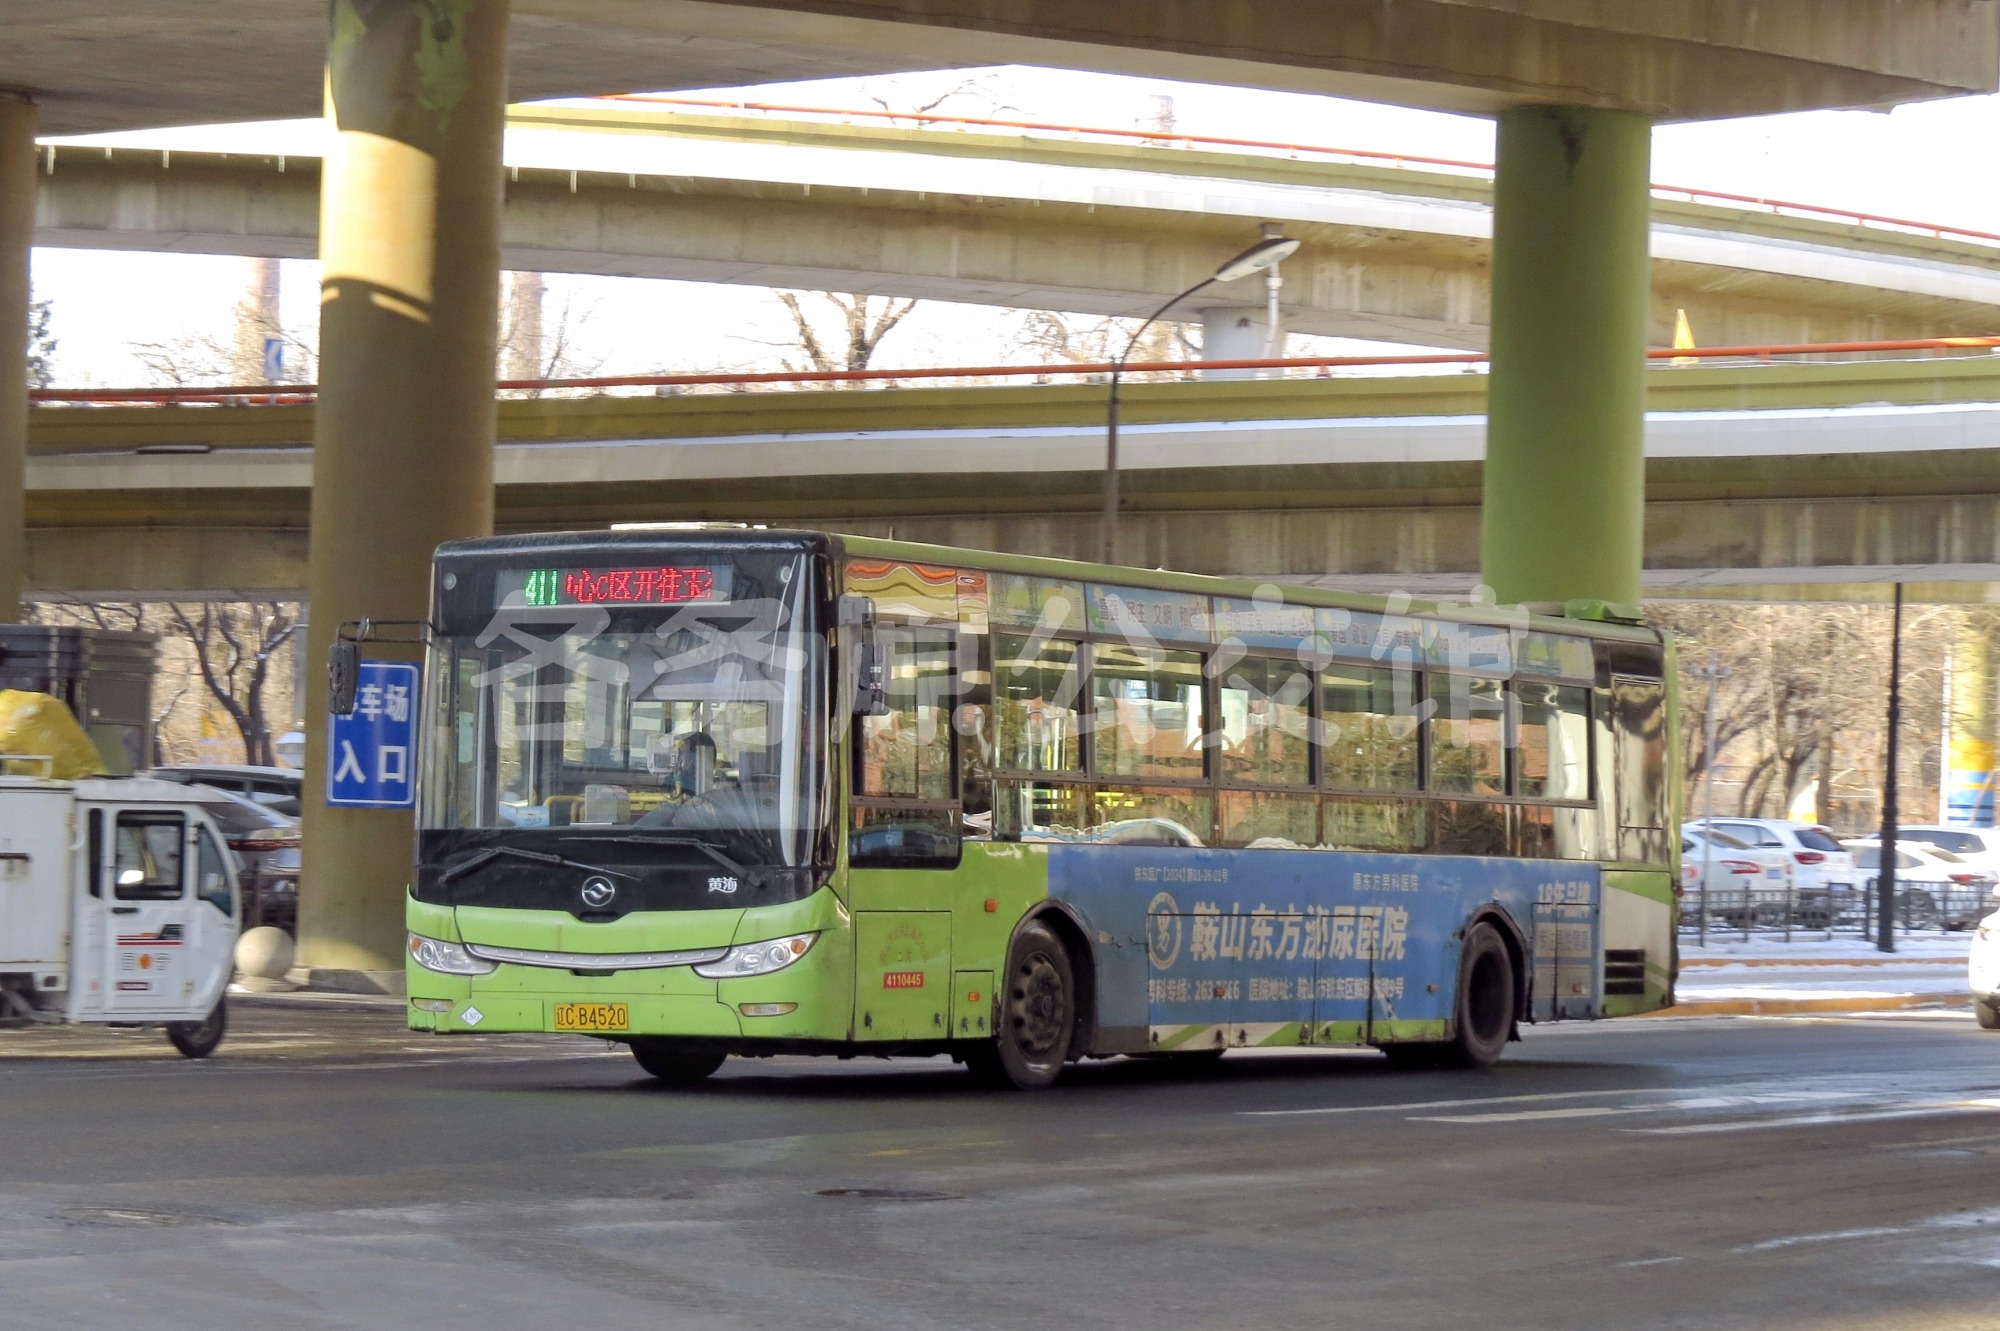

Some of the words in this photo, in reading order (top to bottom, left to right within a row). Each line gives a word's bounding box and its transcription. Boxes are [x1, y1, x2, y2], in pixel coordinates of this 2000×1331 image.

[525, 570, 558, 605] 411
[565, 567, 713, 603] 心C区开往玉
[1126, 601, 1146, 623] 民主
[1153, 603, 1172, 626] 文明
[338, 684, 409, 722] 车场
[334, 740, 407, 783] 入口
[708, 876, 737, 893] 黄海
[1191, 901, 1409, 962] 鞍山东方泌尿医院
[886, 973, 921, 987] 4110445
